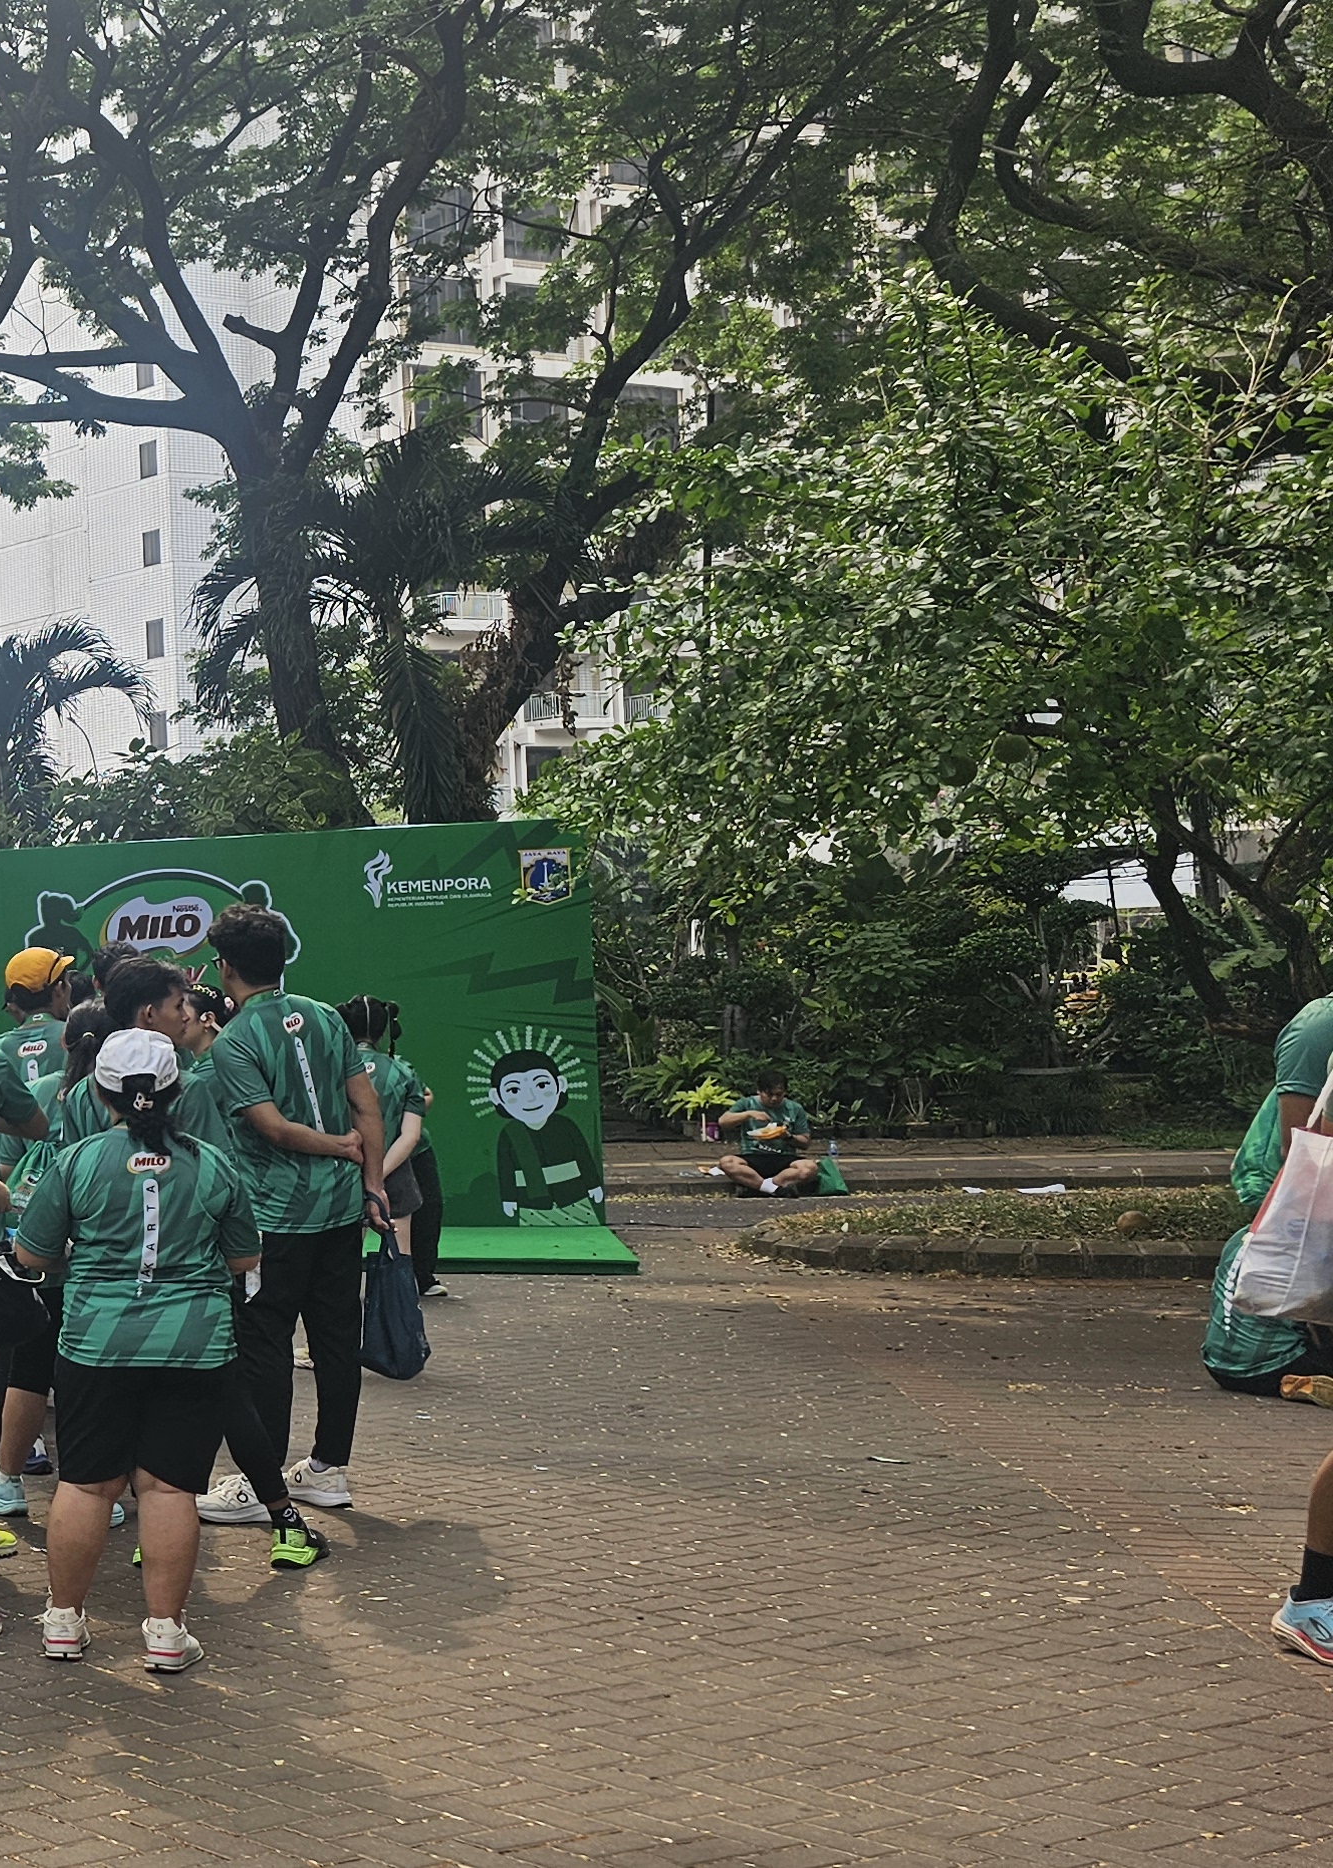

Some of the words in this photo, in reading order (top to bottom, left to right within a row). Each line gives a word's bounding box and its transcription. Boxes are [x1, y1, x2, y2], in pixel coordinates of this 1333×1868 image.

[386, 876, 492, 895] KEMENPORA
[117, 913, 201, 942] MILO
[22, 1044, 44, 1053] MILO
[134, 1157, 166, 1168] MILO
[139, 1184, 157, 1278] AKARTA
